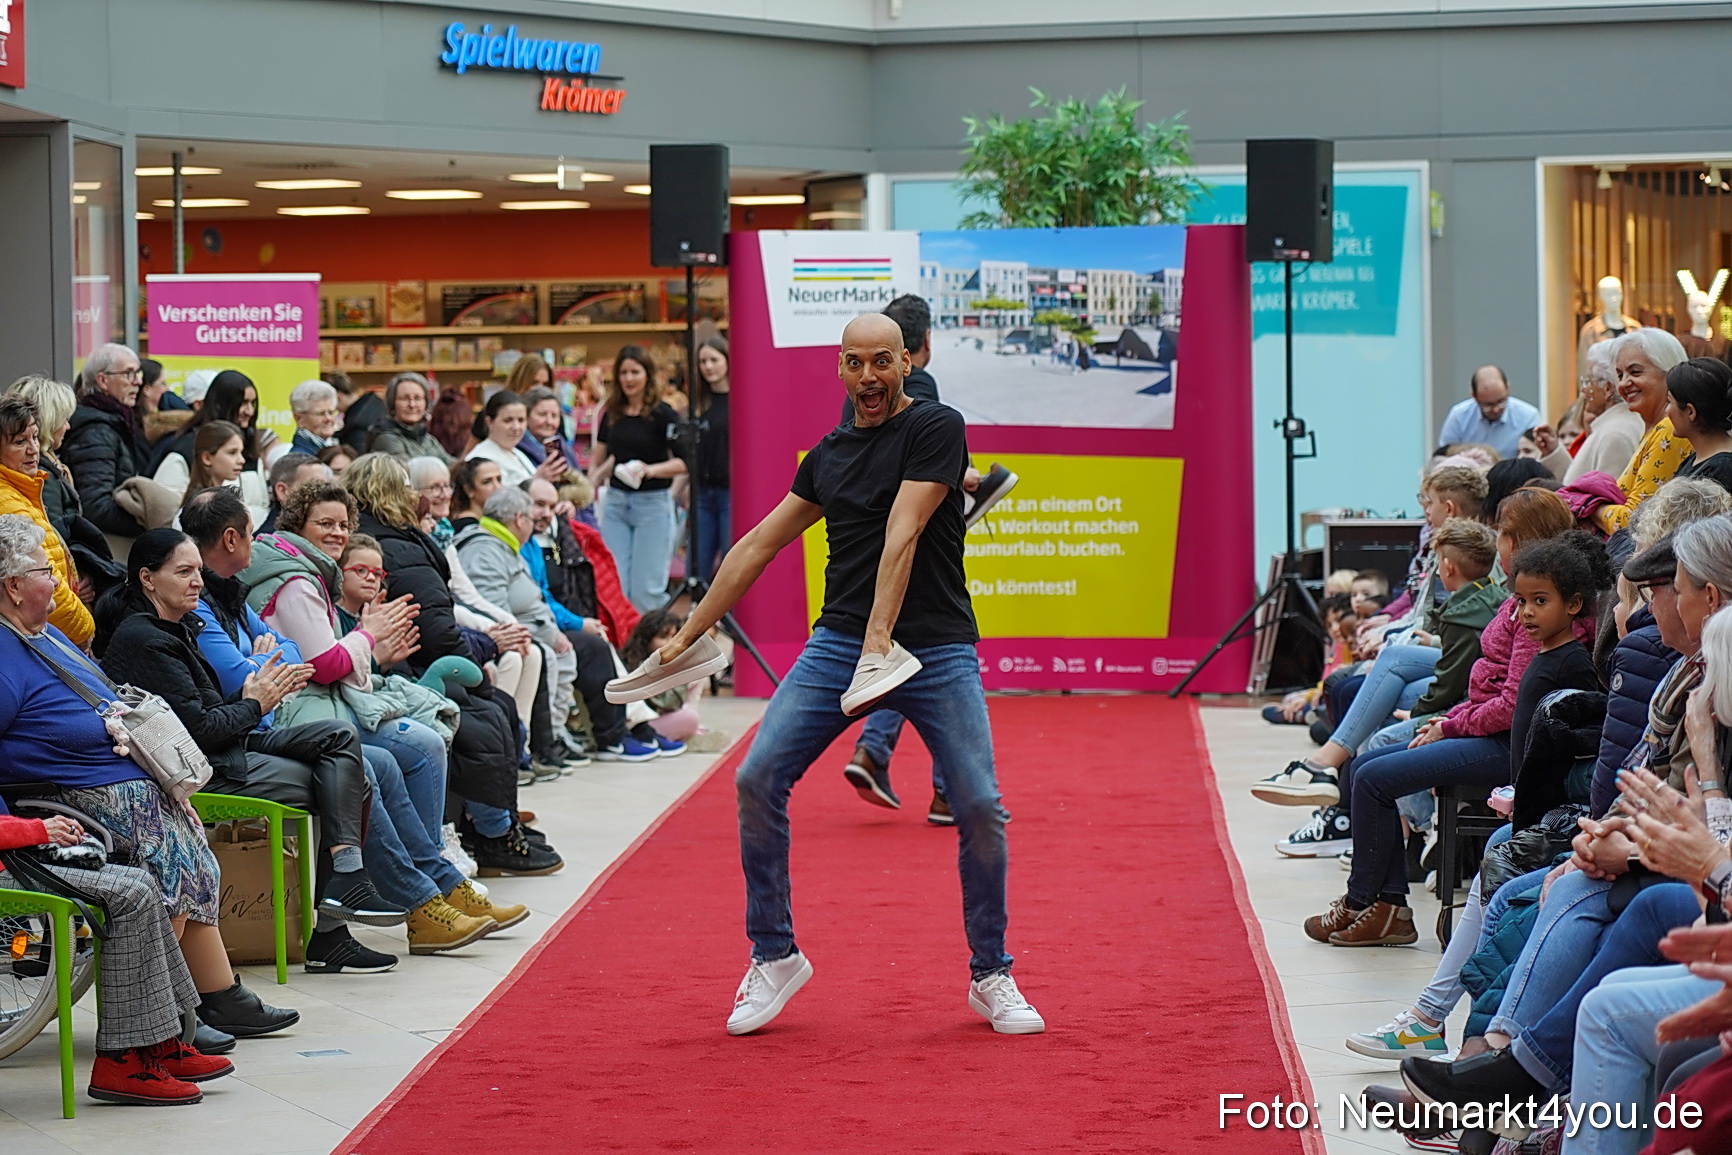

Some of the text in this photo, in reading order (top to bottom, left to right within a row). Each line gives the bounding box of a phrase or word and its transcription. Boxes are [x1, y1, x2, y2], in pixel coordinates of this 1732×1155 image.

[441, 22, 602, 74] Spielwaren
[540, 78, 626, 114] Krömer
[788, 286, 898, 302] NeuerMarkt
[157, 302, 303, 322] Verschenken Sie
[195, 323, 303, 343] Gutscheine!
[1016, 498, 1037, 513] an
[1040, 496, 1092, 513] einem
[1095, 496, 1122, 513] Ort
[999, 518, 1071, 535] Workout
[1073, 519, 1139, 535] machen
[965, 539, 1125, 557] aumurlaub buchen.
[969, 579, 1077, 596] Du könntest!
